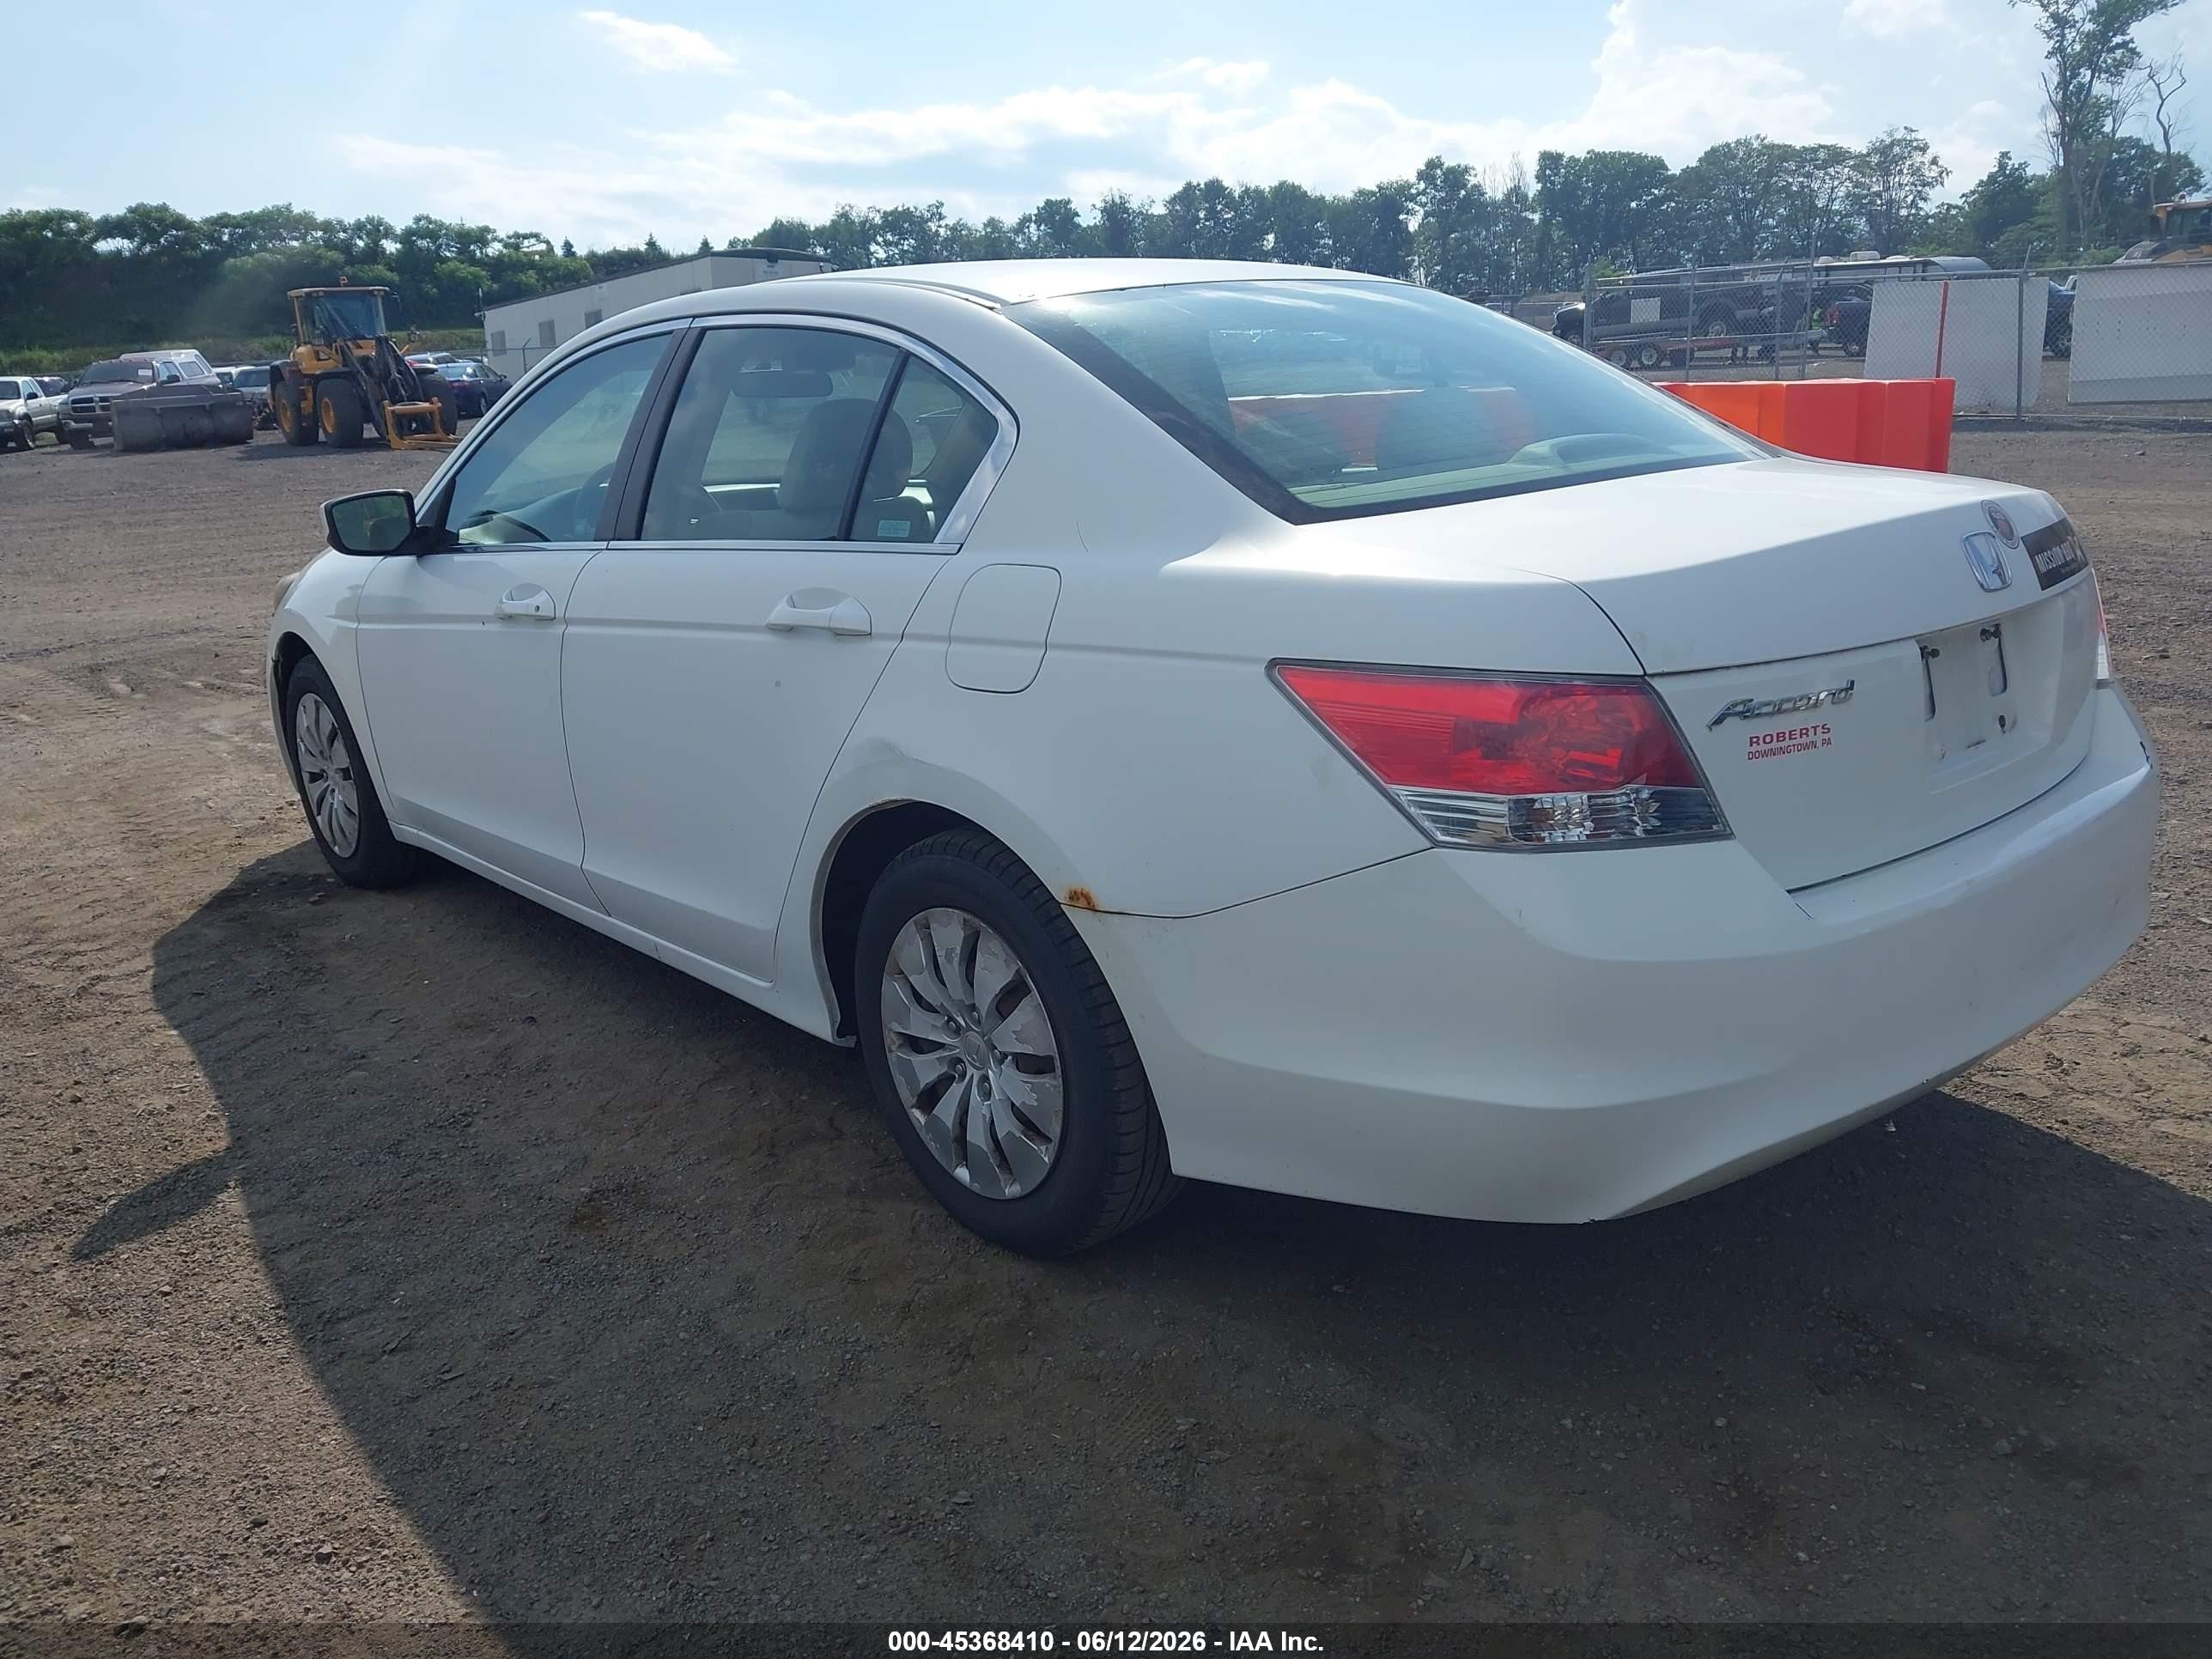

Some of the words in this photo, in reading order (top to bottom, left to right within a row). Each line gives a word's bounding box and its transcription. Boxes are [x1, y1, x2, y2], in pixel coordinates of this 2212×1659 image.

[1706, 679, 1856, 732] Accord
[1749, 723, 1832, 747] ROBERTS
[1747, 740, 1820, 761] DOWNINGTOWN,
[1821, 737, 1832, 748] PA
